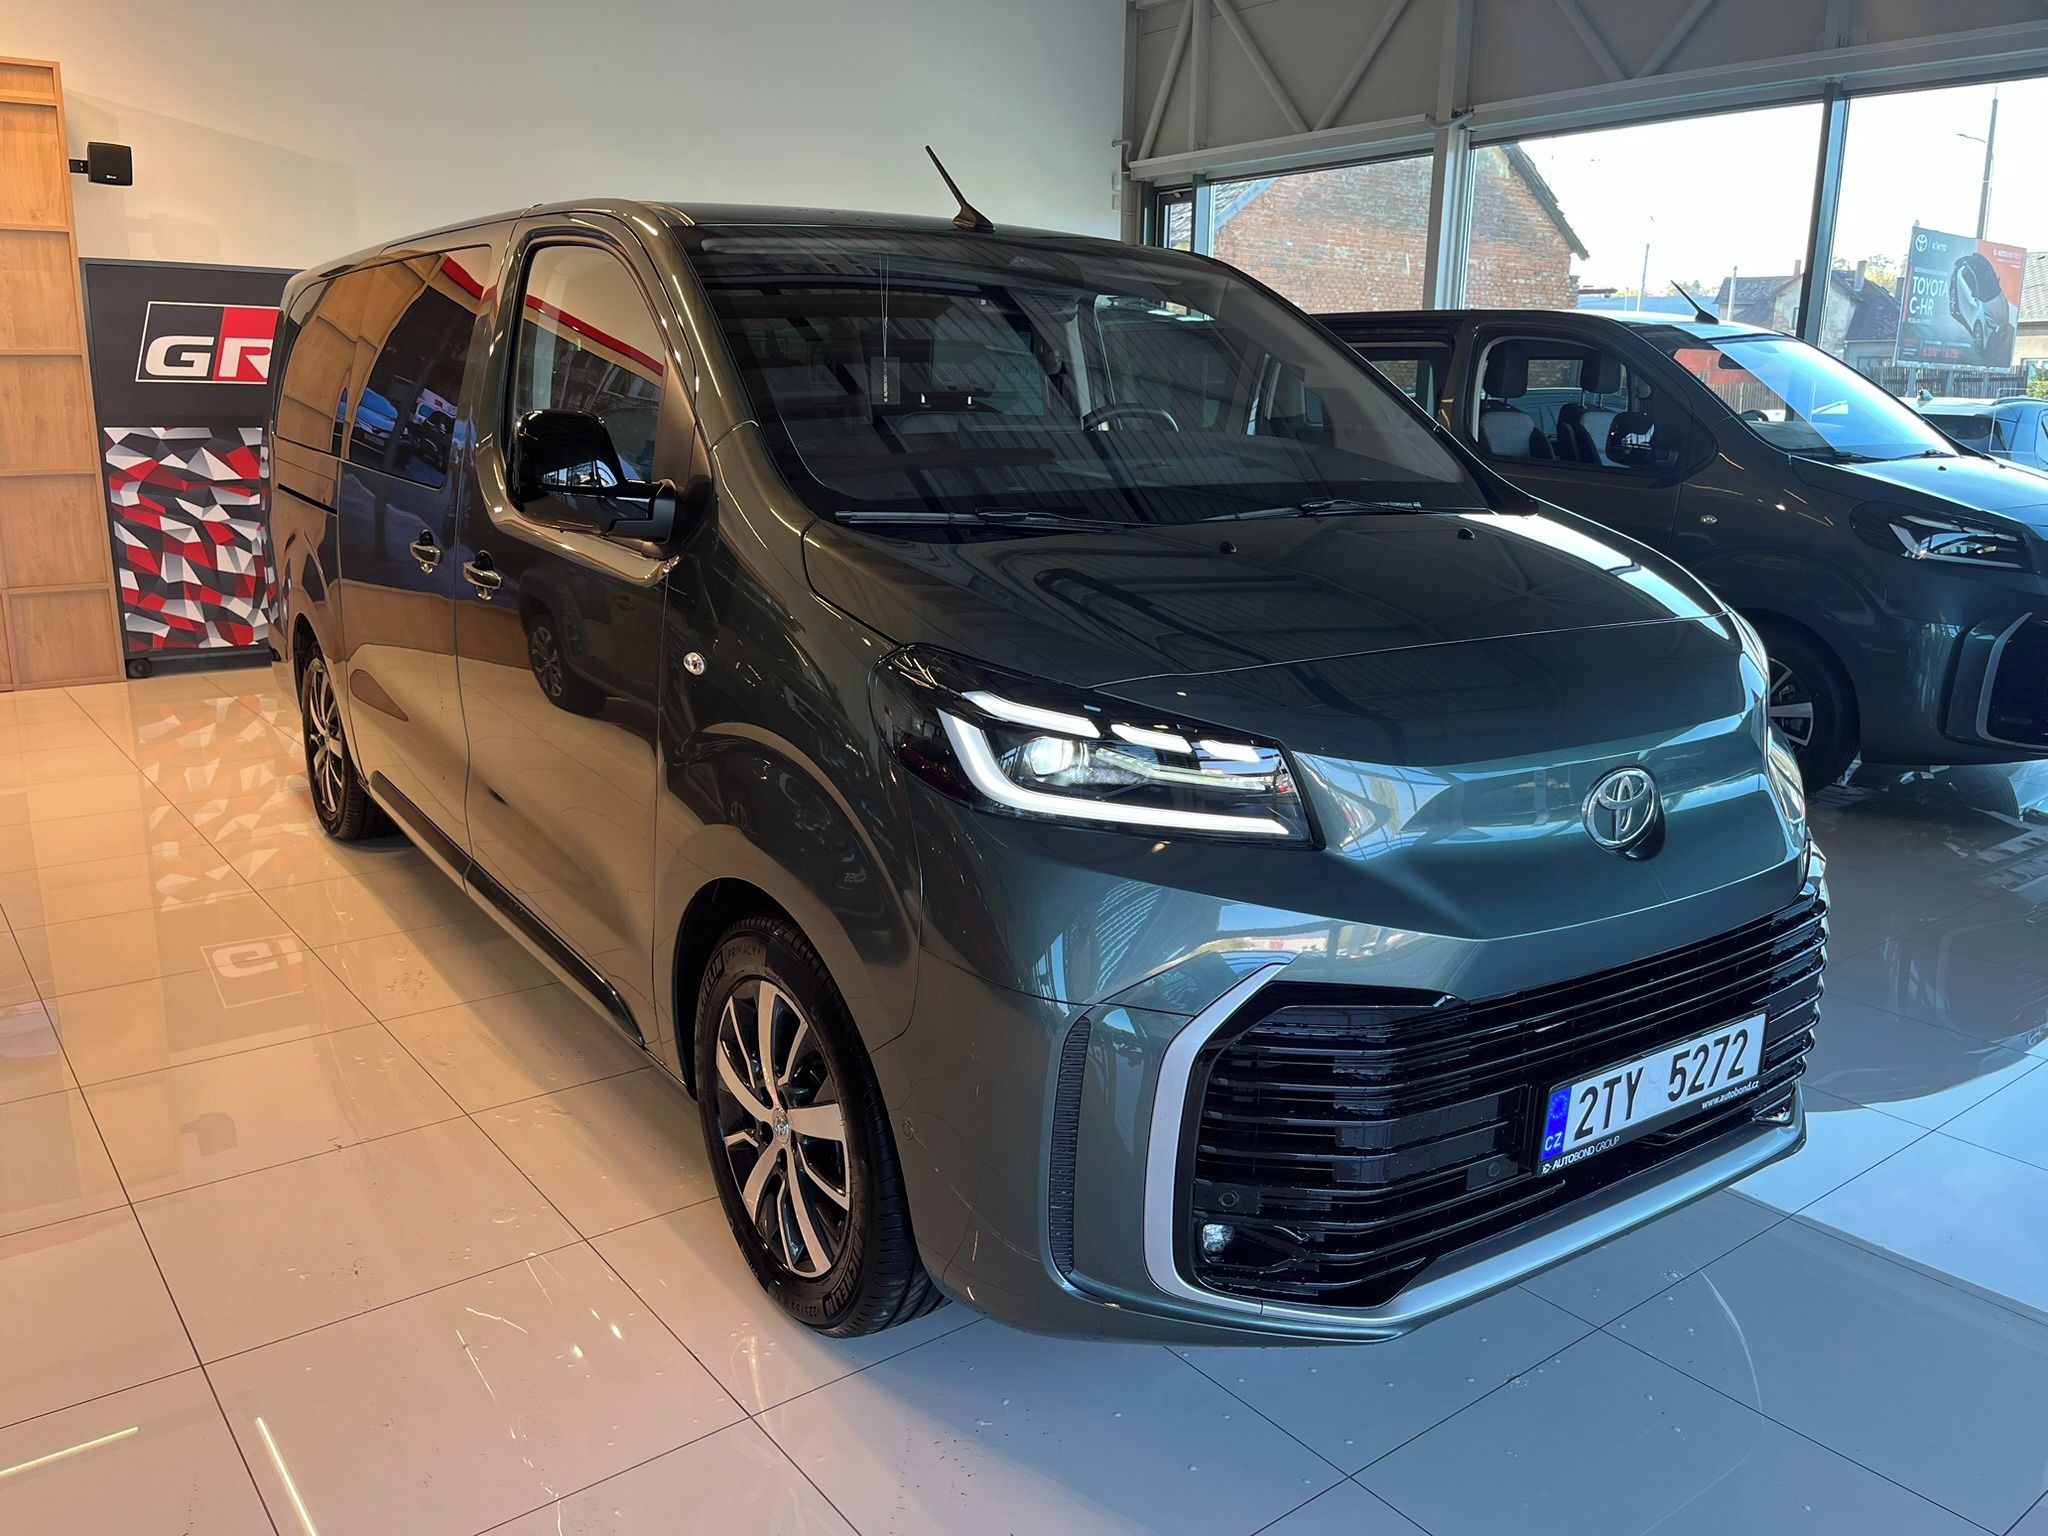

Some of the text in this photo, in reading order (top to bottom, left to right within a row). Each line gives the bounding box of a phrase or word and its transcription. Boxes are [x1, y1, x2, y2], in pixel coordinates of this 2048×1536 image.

[1912, 276, 1949, 297] TOYOTA
[1909, 296, 1934, 317] C-HR
[145, 335, 273, 379] GR
[1573, 1028, 1748, 1142] 2TY 5272
[1701, 1079, 1760, 1110] www.autobond.cz
[1543, 1131, 1563, 1152] CZ
[1551, 1135, 1620, 1171] AUTOBOND GROUP
